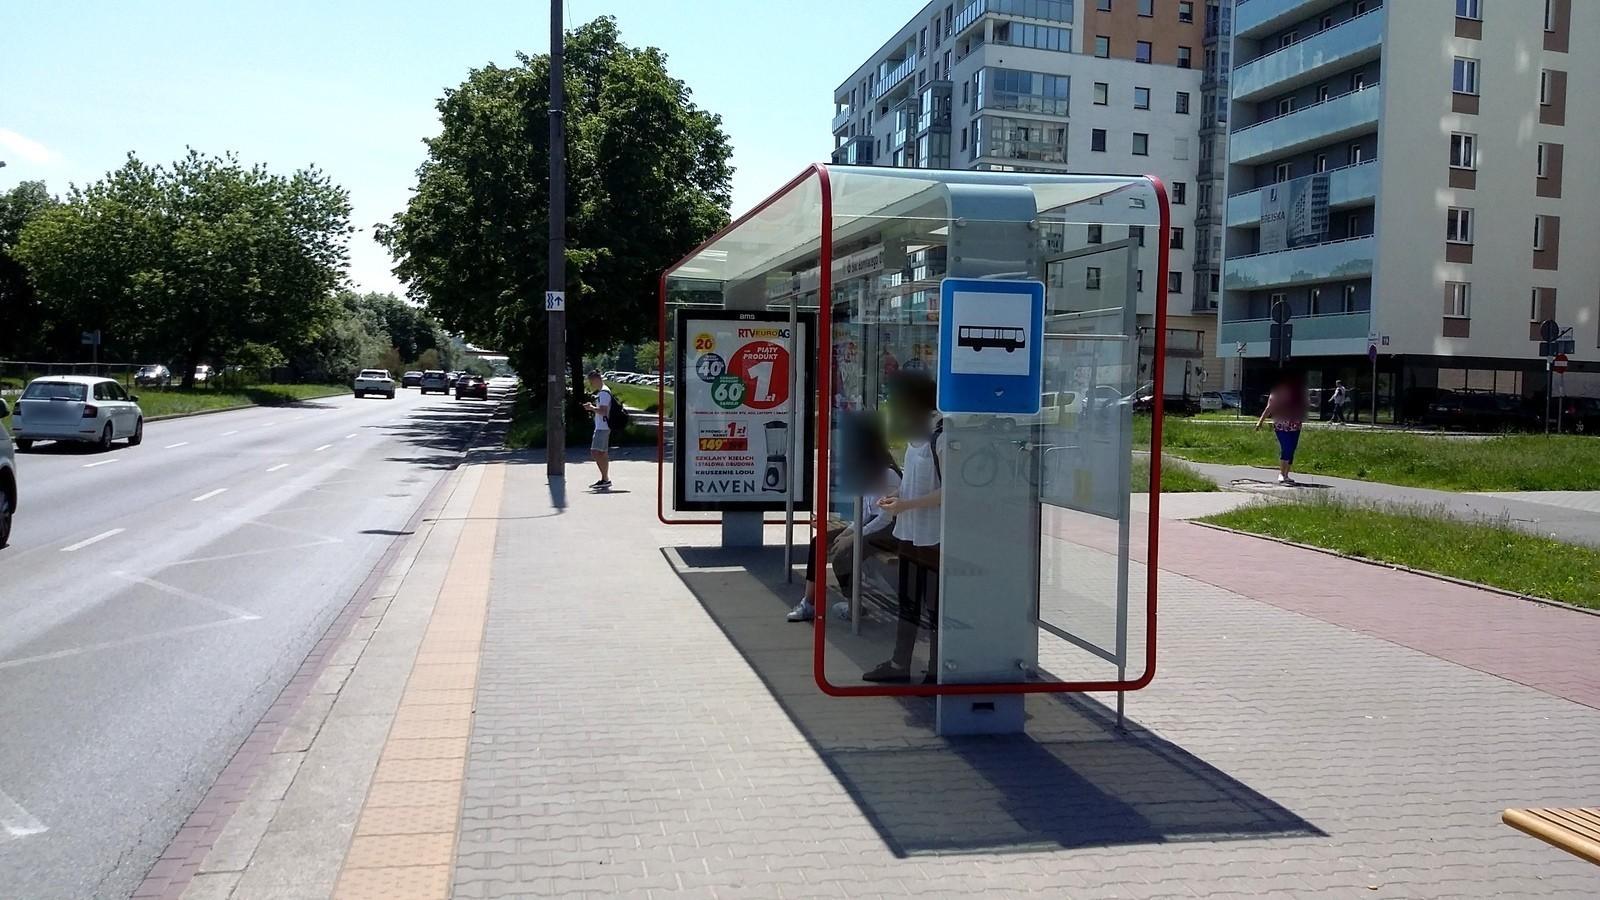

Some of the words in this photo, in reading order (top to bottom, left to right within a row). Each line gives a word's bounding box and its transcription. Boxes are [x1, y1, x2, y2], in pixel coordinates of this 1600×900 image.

[696, 338, 713, 350] 20
[748, 361, 774, 401] 1
[728, 422, 736, 437] 1
[695, 480, 755, 493] RAVEN
